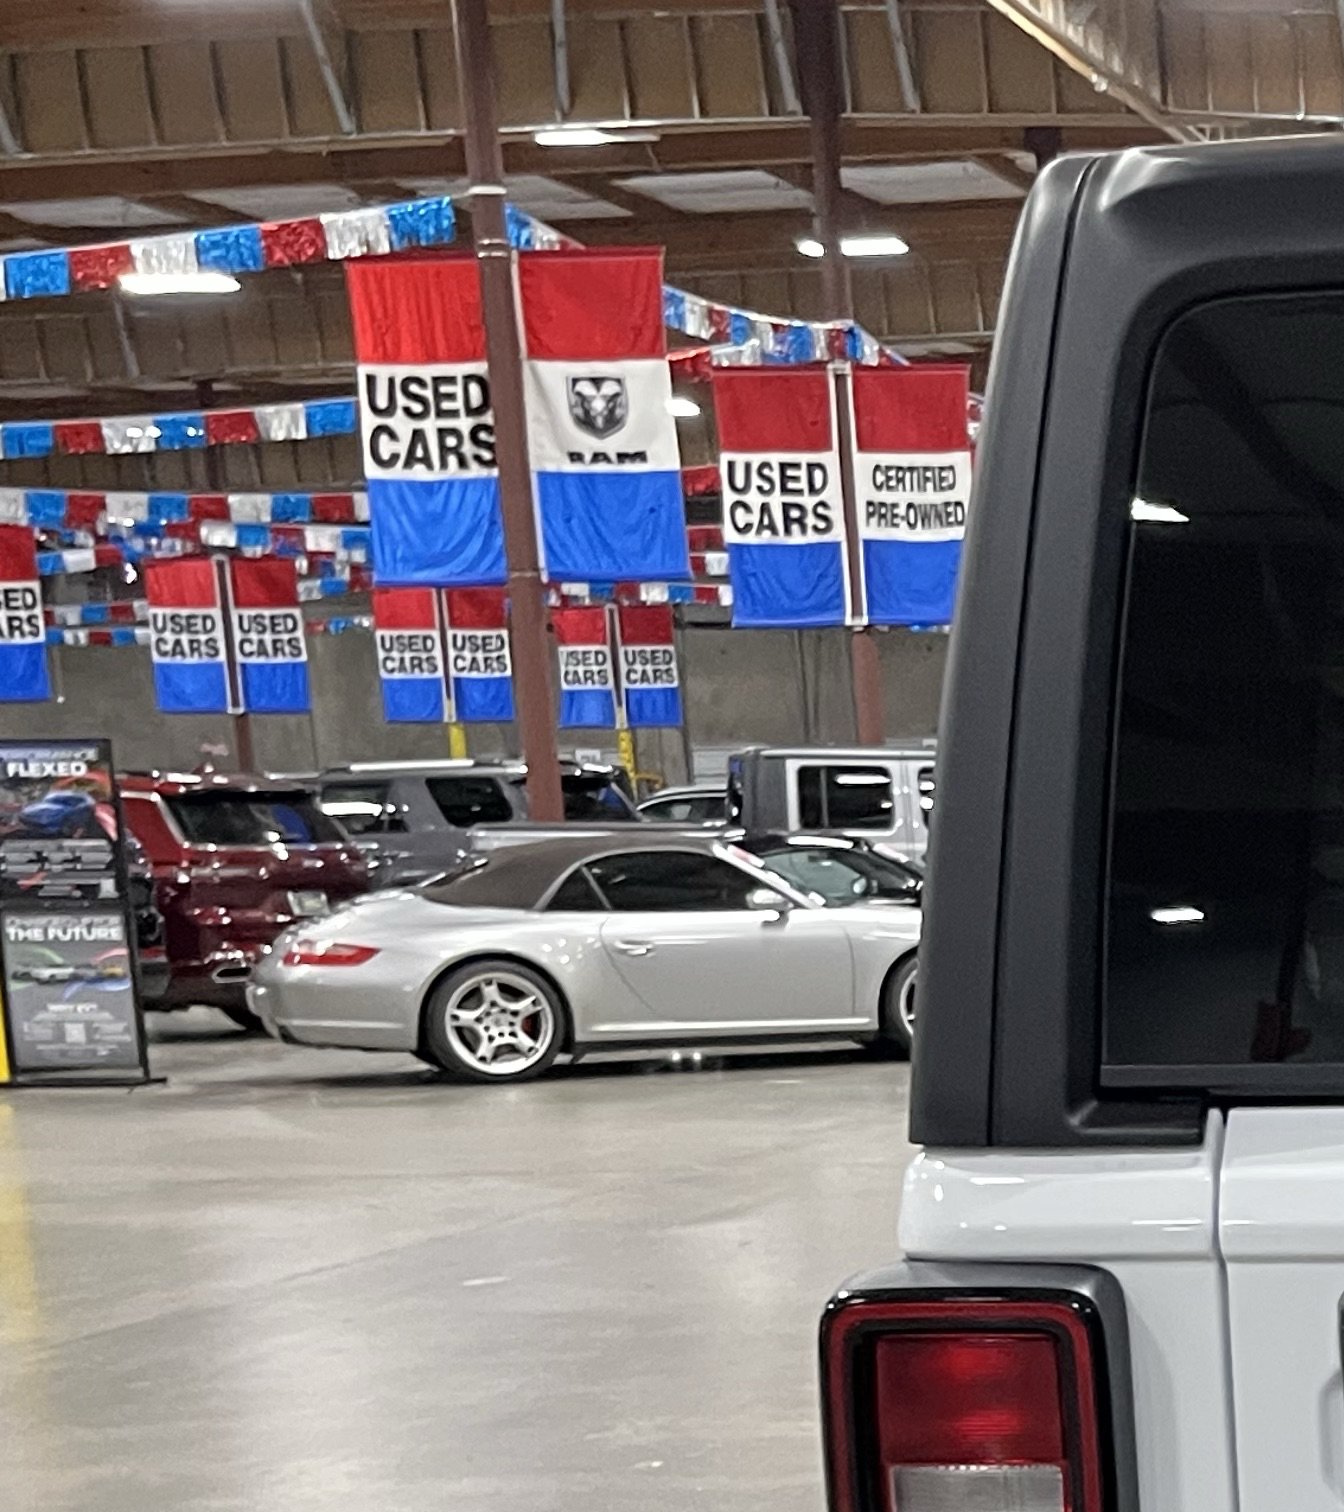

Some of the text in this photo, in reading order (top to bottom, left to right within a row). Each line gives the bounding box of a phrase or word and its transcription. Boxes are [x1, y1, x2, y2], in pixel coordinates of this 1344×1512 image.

[366, 374, 491, 420] USED
[369, 424, 498, 471] CARS
[567, 450, 648, 465] RAM
[727, 460, 829, 497] USED
[872, 464, 957, 493] CERTIFIED
[729, 499, 834, 537] CARS
[865, 500, 965, 530] PRE-OWNED
[0, 615, 40, 639] RS
[153, 613, 216, 634] USED
[238, 613, 298, 634] USED
[155, 638, 221, 659] CARS
[239, 638, 303, 659] CARS
[380, 634, 436, 653] USED
[452, 634, 506, 653] USED
[381, 655, 439, 674] CARS
[453, 655, 508, 673] CARS
[624, 649, 673, 666] USED
[563, 669, 609, 686] CARS
[625, 668, 675, 685] CARS
[7, 762, 88, 778] FLEXED
[6, 926, 124, 941] THE FUTURE
